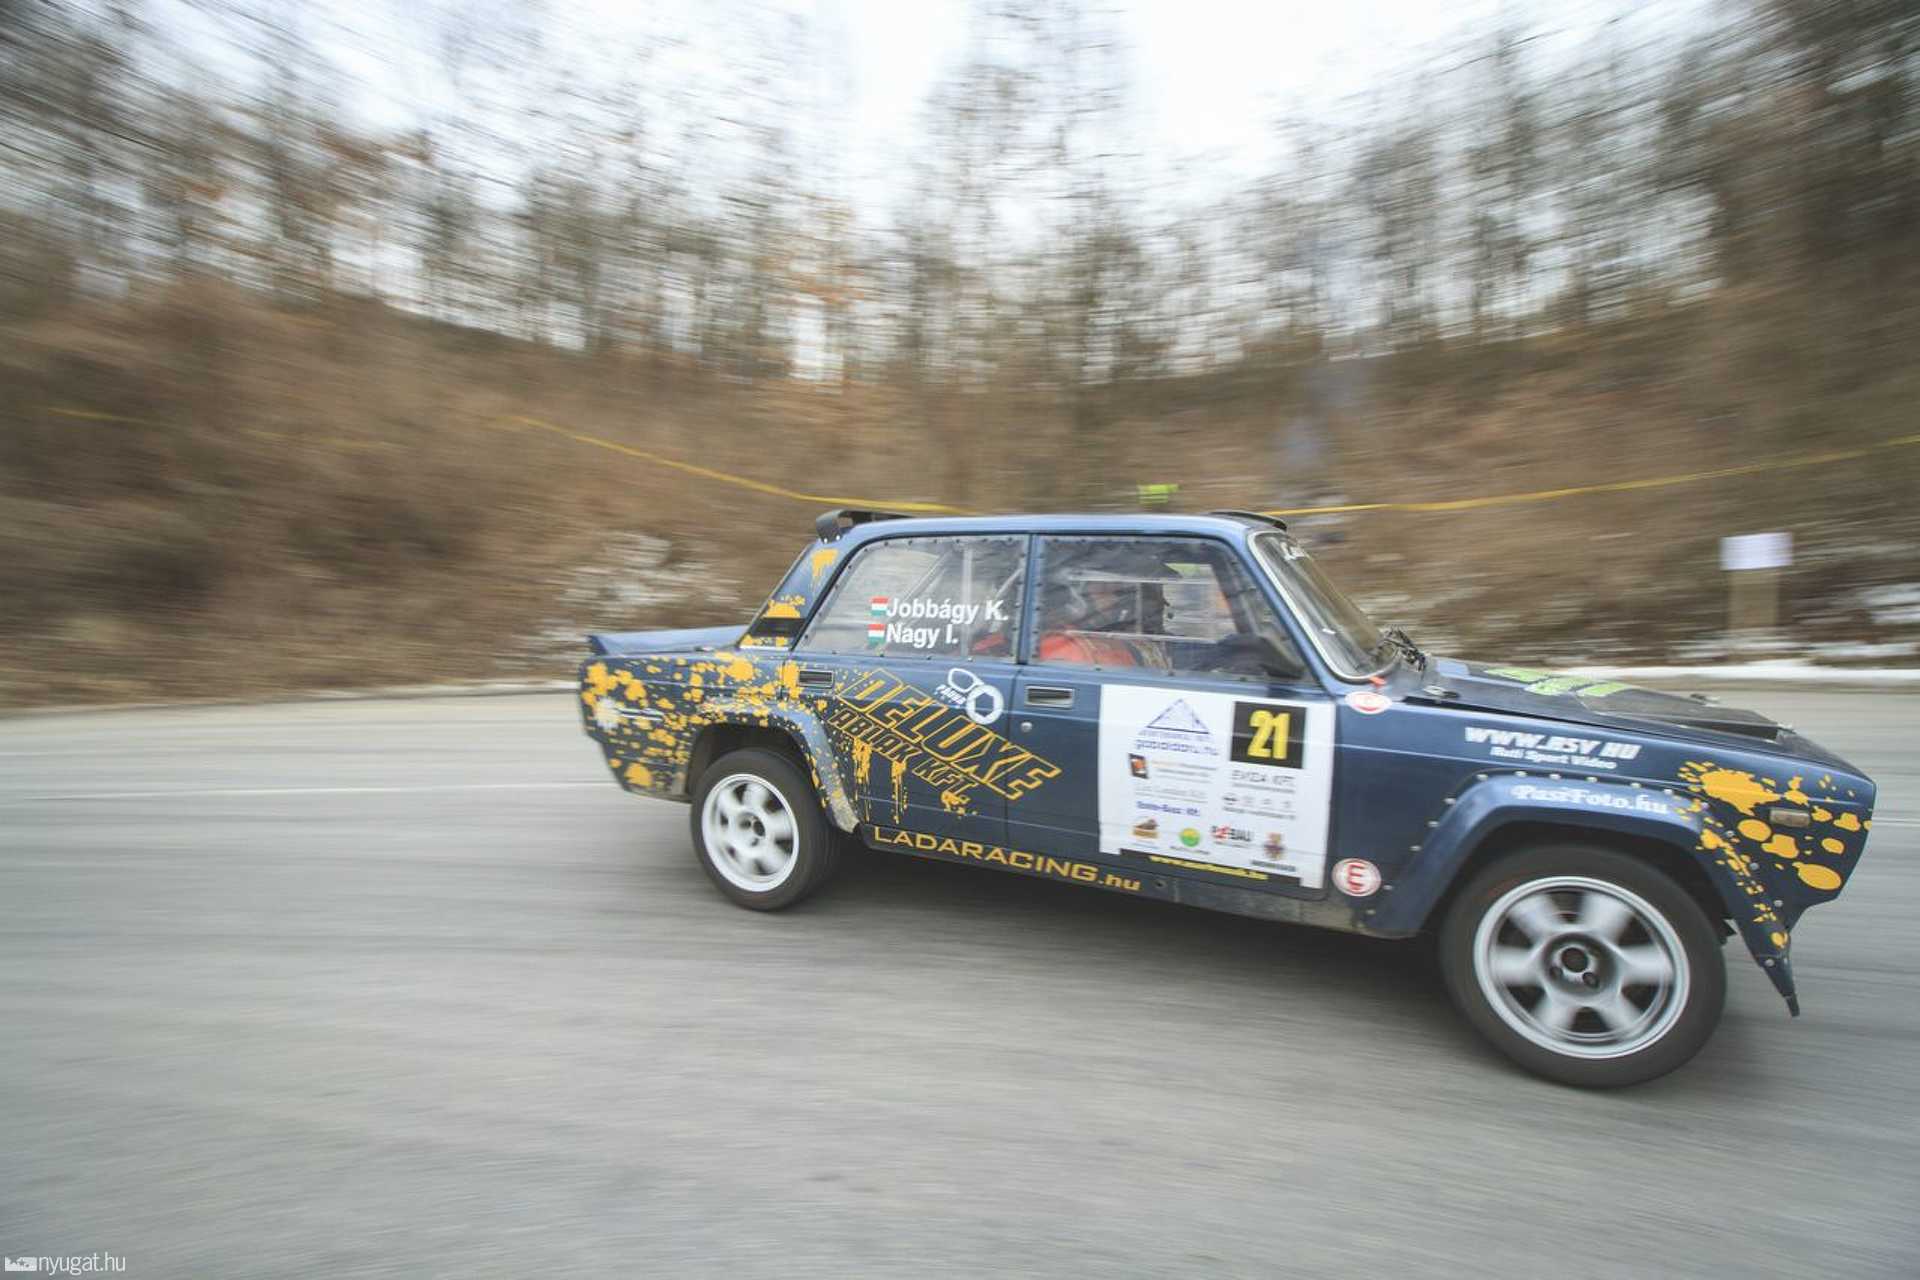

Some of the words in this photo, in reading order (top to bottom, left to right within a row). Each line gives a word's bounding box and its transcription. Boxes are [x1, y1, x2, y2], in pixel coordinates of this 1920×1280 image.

[886, 598, 979, 624] Jobbágy
[984, 599, 1009, 621] K.
[886, 623, 940, 649] Nagy
[1247, 709, 1291, 760] 21
[1346, 862, 1364, 891] E
